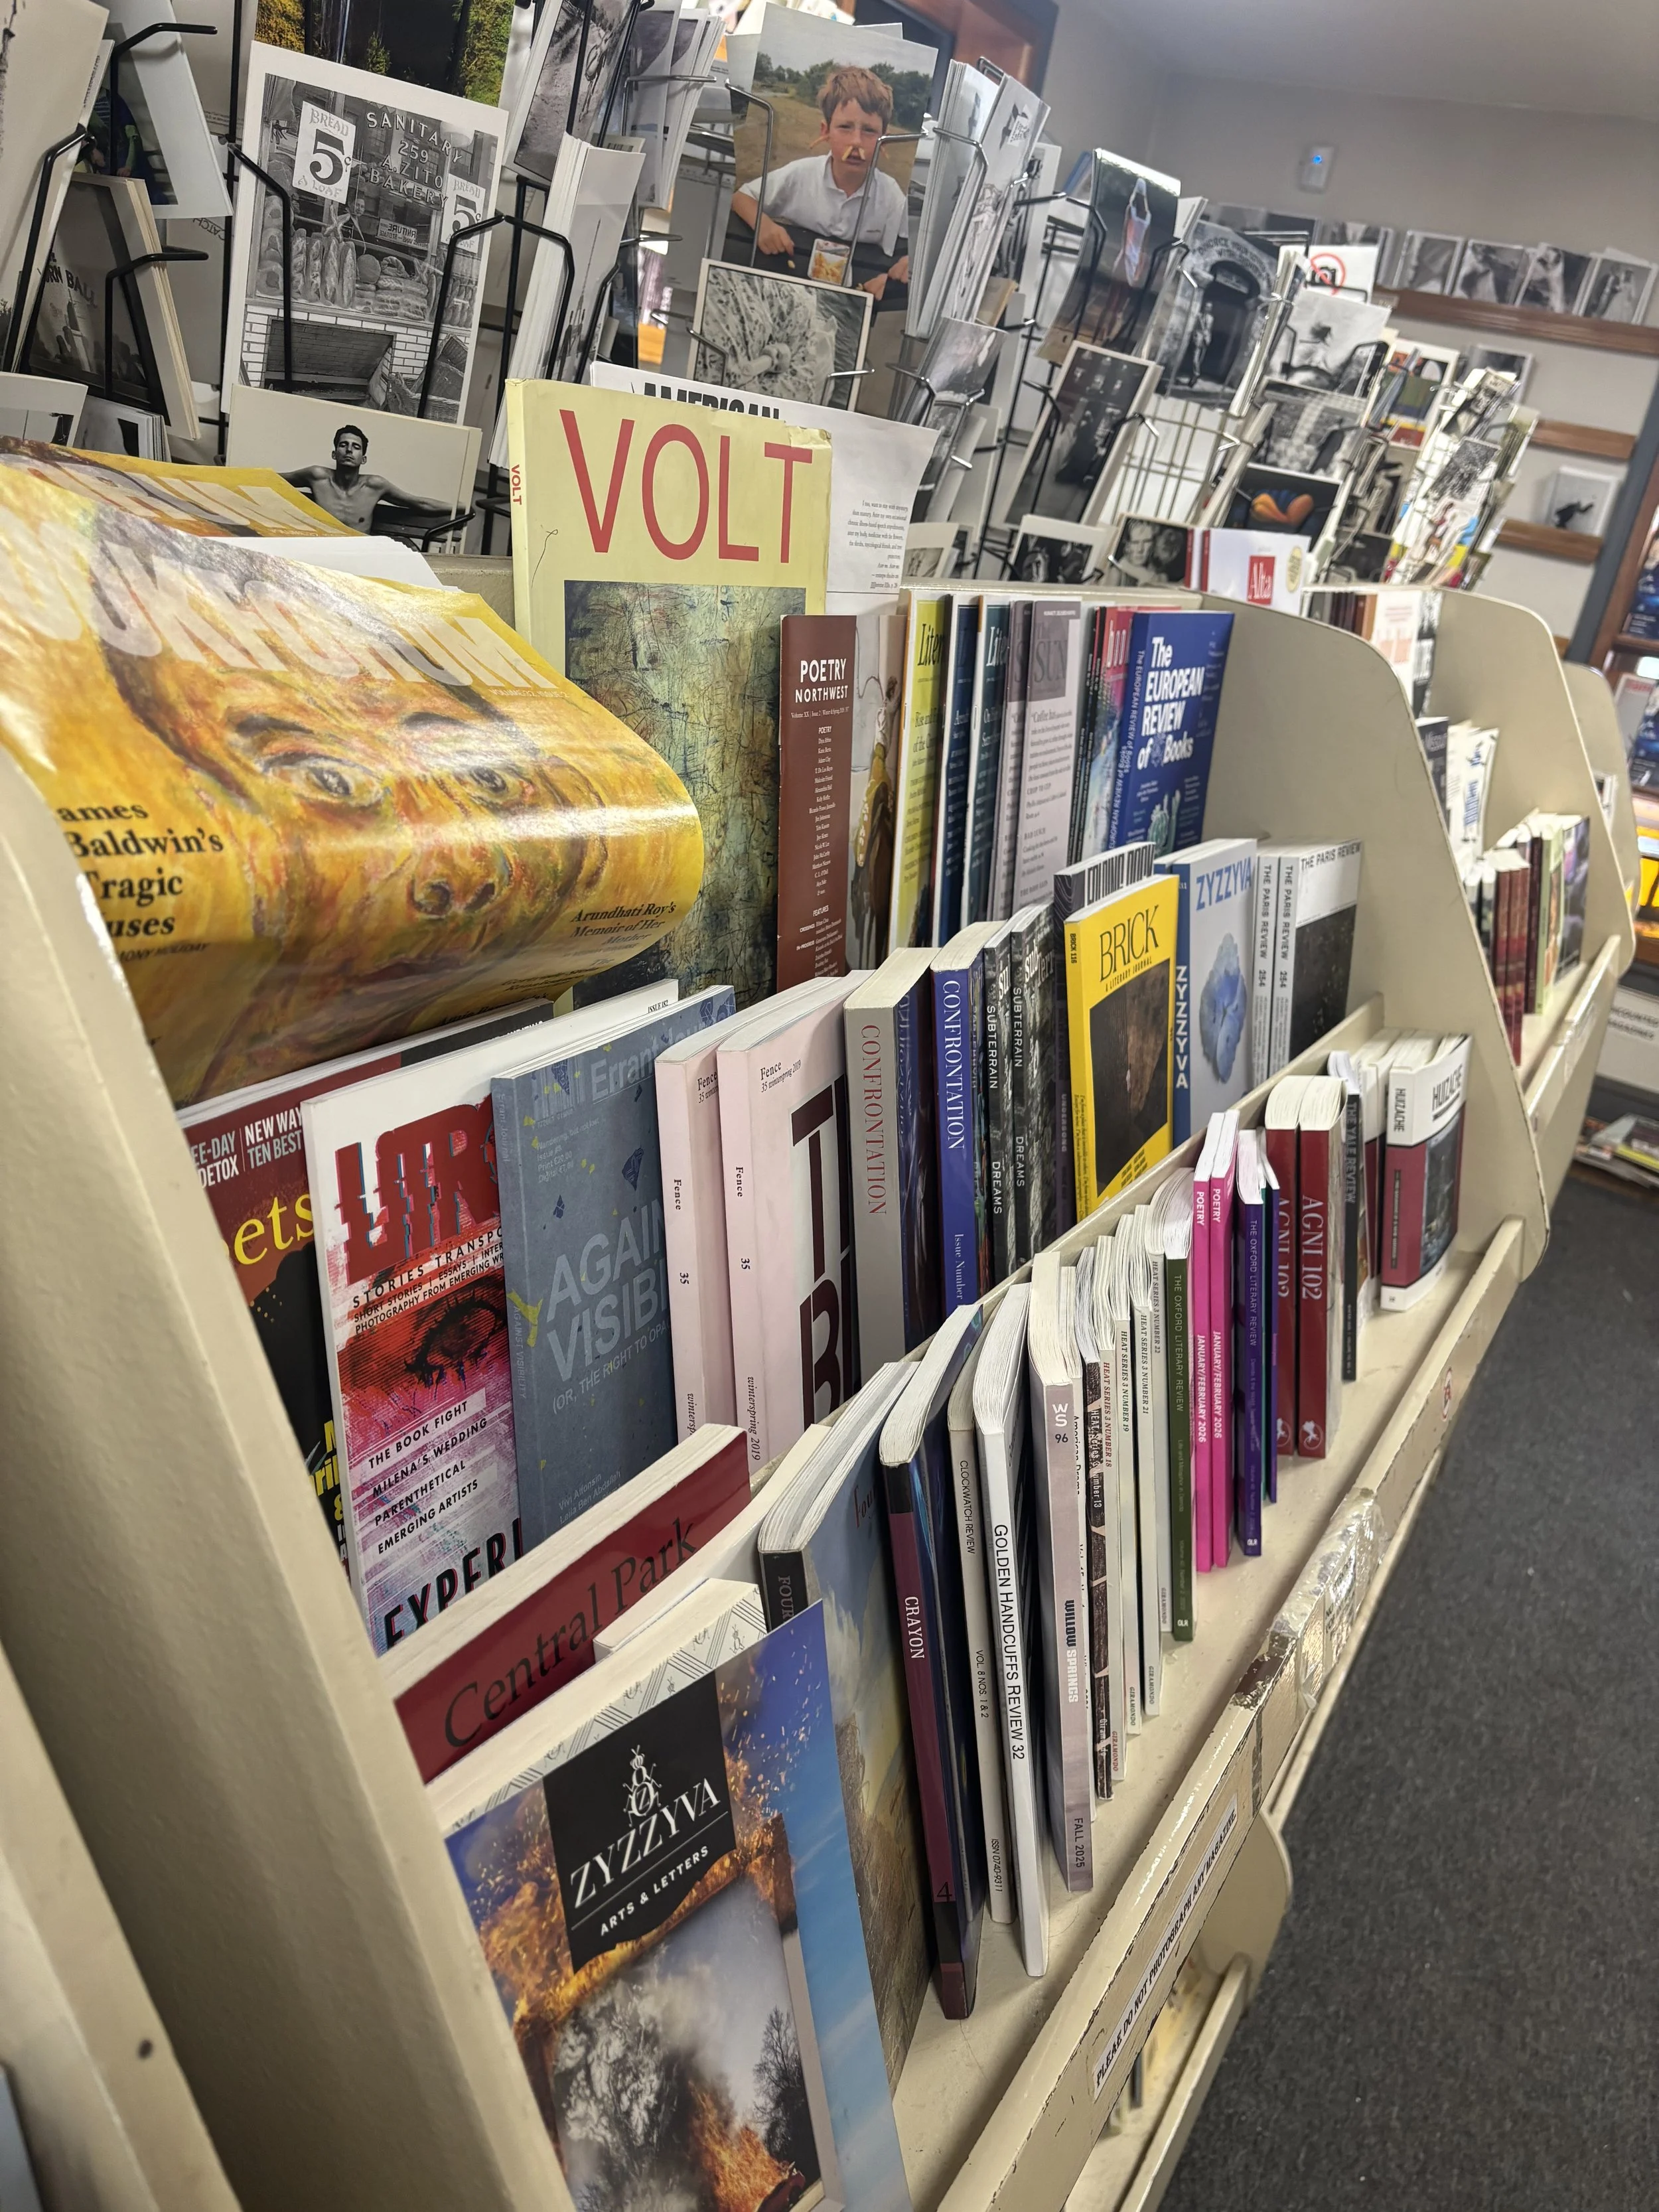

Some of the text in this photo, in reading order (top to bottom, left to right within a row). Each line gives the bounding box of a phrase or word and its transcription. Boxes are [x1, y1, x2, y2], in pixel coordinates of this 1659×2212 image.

[309, 108, 350, 137] BREAD
[366, 111, 463, 164] SANITARY
[398, 139, 429, 163] 259
[370, 168, 449, 209] BAKERY
[510, 463, 523, 506] VOLT
[559, 409, 813, 564] VOLT
[800, 658, 847, 683] POETRY
[1151, 636, 1173, 669] The
[795, 686, 849, 703] NORTHWEST
[1128, 664, 1143, 738] EUROPEAN REVIEW
[1145, 666, 1205, 702] EUROPEAN
[1141, 700, 1186, 737] REVIEW
[1137, 731, 1194, 770] of Books
[1109, 808, 1120, 849] EUROPEAN
[1196, 856, 1252, 912] ZYZZYVA
[1301, 848, 1336, 872] THE PARIS
[570, 922, 624, 938] Memoir
[571, 901, 677, 923] Arundhati Roy's
[1260, 864, 1272, 960] THE PARIS REVIEW
[1281, 865, 1294, 961] THE PARIS REVIEW
[1099, 905, 1159, 982] BRICK
[1110, 955, 1153, 990] LITERARY JOURNAL
[1175, 965, 1188, 1089] ZYZZYVA
[697, 1071, 718, 1091] Fence
[760, 1061, 782, 1081] Fence
[1013, 987, 1025, 1187] SUBTERRAIN DREAMS
[244, 1116, 274, 1146] NEW
[861, 1025, 887, 1216] CONFRONTATION
[942, 980, 966, 1299] CONFRONTATION Issue Number
[986, 1005, 1003, 1215] SUBTERRAIN DREAMS
[1394, 1088, 1406, 1133] HUIZACHE
[197, 1130, 303, 1189] DETOX TEN BEST
[1344, 1120, 1358, 1205] YALE REVIEW
[674, 1179, 689, 1286] Fence 35
[1249, 1219, 1258, 1236] THE
[1249, 1238, 1258, 1273] OXFORD
[1302, 1195, 1325, 1301] AGNI 102
[353, 1264, 425, 1309] STORIES
[354, 1258, 467, 1323] SHORT STORIES ESSAYS
[355, 1260, 490, 1335] PHOTOGRAPHY FROM EMERGING
[1174, 1274, 1183, 1291] THE
[735, 1166, 761, 1461] Fence 35 winterspring 2019
[1174, 1295, 1183, 1331] OXFORD
[1196, 1191, 1208, 1443] POETRY JANUARY/FEBRUARY 2026
[1212, 1187, 1224, 1439] POETRY JANUARY/FEBRUARY 2026
[514, 1305, 527, 1399] AGAINST VISIBILITY
[552, 1335, 648, 1415] (OR, THE RIGHT TO
[368, 1400, 469, 1469] THE BOOK FIGHT
[372, 1418, 488, 1499] MILENA'S WEDDING
[1054, 1434, 1069, 1445] 96
[374, 1460, 466, 1526] PARENTHETICAL
[378, 1479, 479, 1555] EMERGING ARTISTS
[578, 1496, 593, 1510] Ben
[959, 1460, 976, 1554] CLOCKWATCH REVIEW
[777, 1575, 795, 1620] FOUR
[443, 1518, 698, 1749] Central Park
[904, 1595, 925, 1660] CRAYON
[994, 1524, 1025, 1760] GOLDEN HANDCUFFS REVIEW 32
[1064, 1599, 1080, 1704] WILLOW SPRINGS
[569, 1777, 721, 1911] ZYZZYVA
[991, 1838, 1003, 1892] ISSN 0740-9311
[1074, 1817, 1086, 1868] FALL 2025
[599, 1844, 710, 1936] ARTS & LETTERS
[935, 1881, 954, 1901] 4
[1122, 2010, 1134, 2039] DO
[1133, 1982, 1149, 2012] NOT
[1148, 1899, 1192, 1984] PHOTOGRAPH
[1192, 1866, 1205, 1902] ANY
[1204, 1808, 1237, 1876] MAGAZINE
